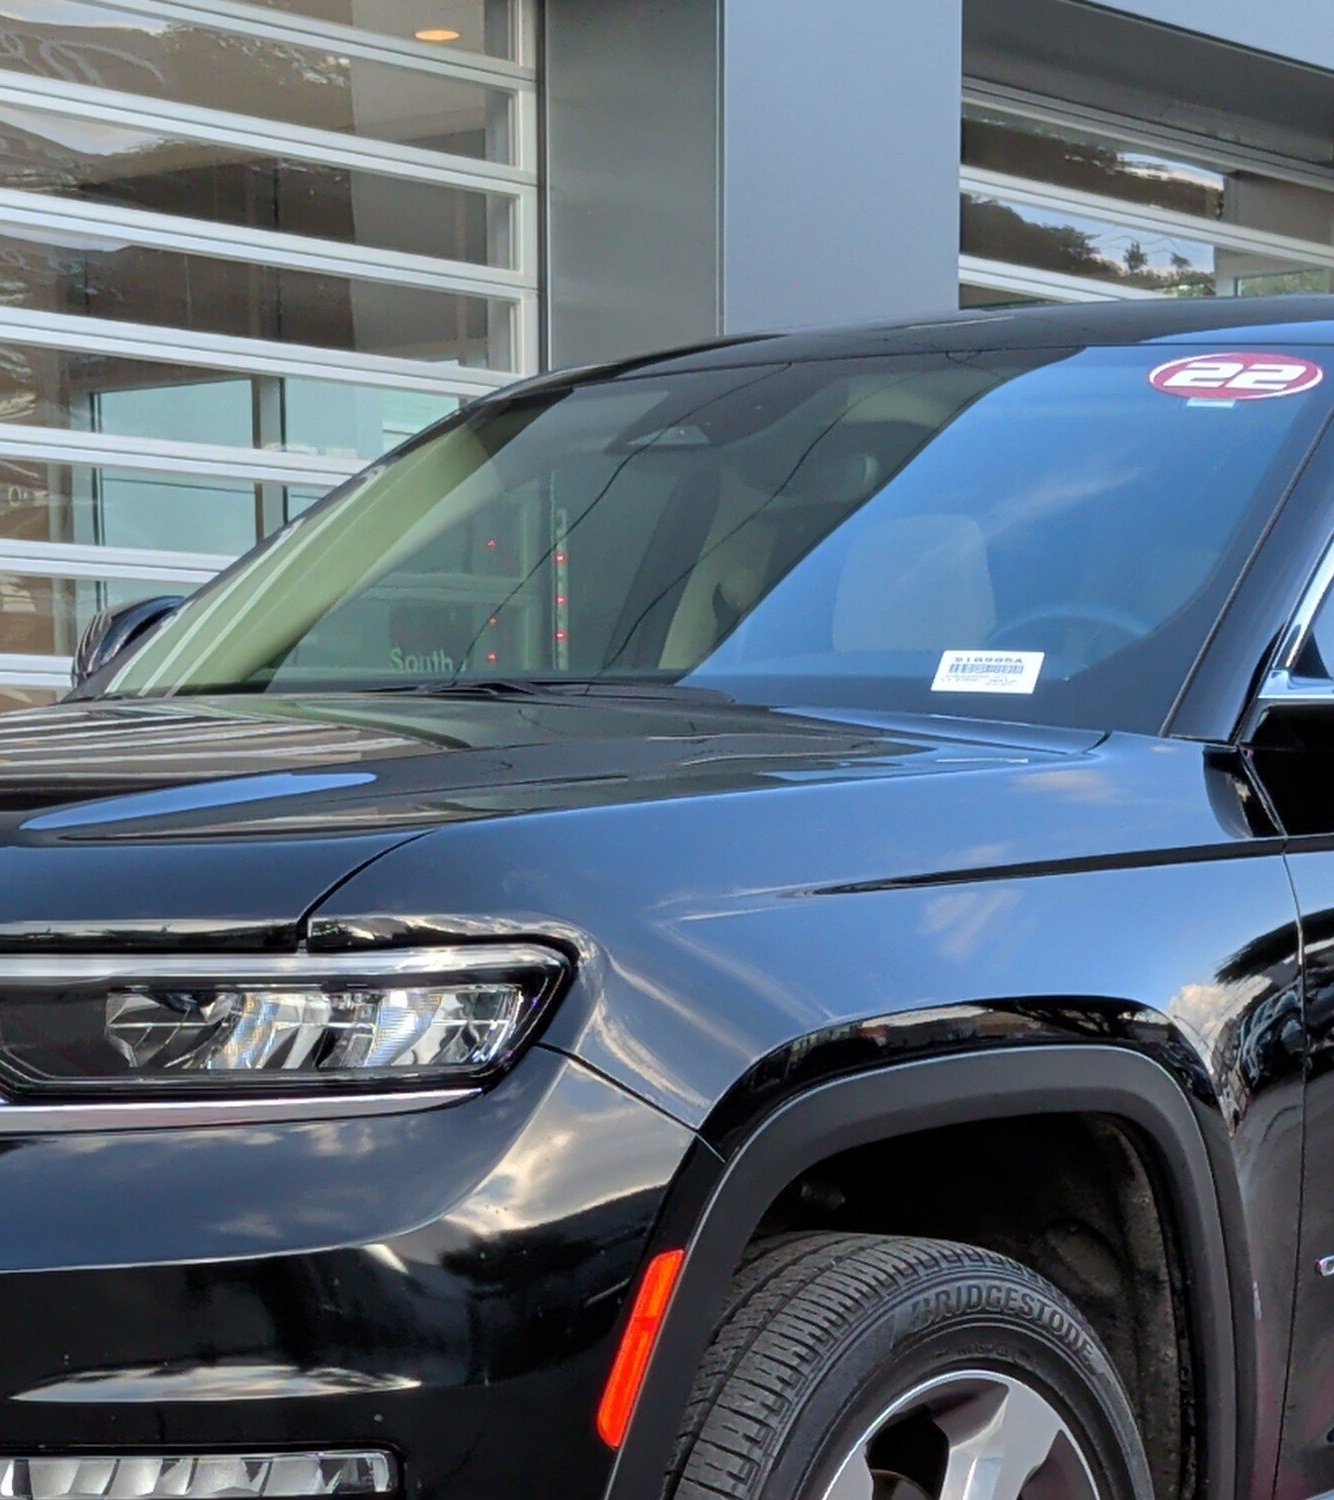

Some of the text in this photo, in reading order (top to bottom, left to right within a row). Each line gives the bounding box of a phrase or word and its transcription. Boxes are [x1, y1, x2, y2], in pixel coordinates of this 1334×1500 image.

[1162, 362, 1307, 390] 22
[390, 647, 453, 673] South
[909, 1284, 1096, 1362] BRIDGESTONE
